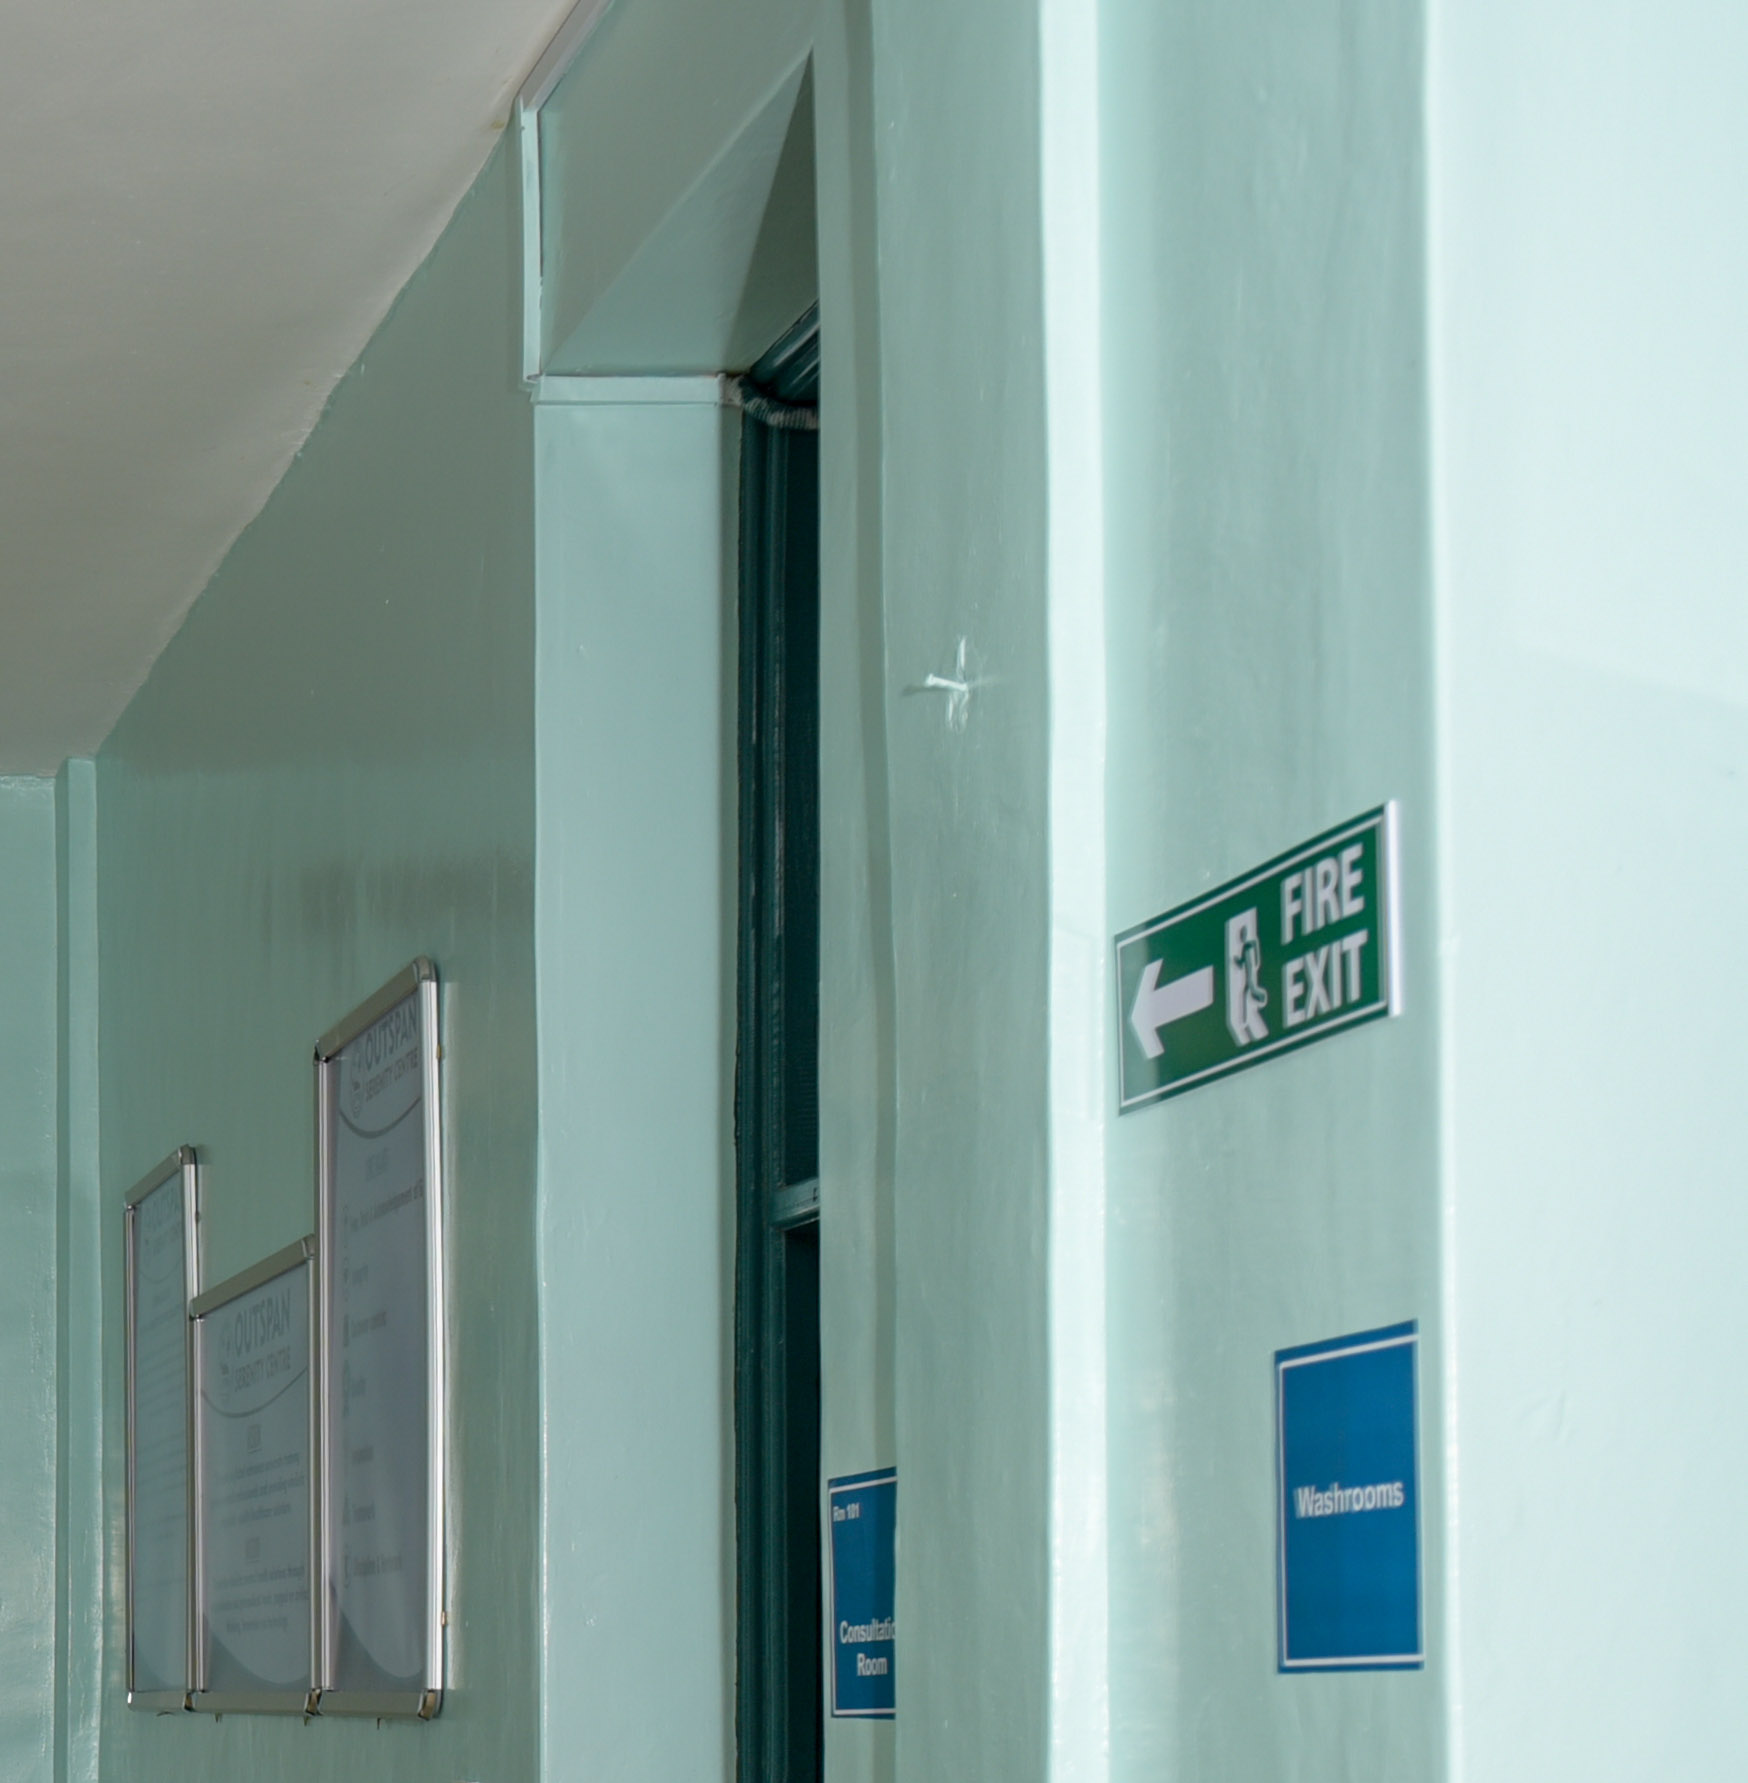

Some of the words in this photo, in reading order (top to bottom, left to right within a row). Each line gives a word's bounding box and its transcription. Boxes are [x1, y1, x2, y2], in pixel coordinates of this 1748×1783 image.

[1281, 842, 1364, 946] FIRE
[1282, 929, 1368, 1029] EXIT
[365, 997, 417, 1072] OUTSPAN
[234, 1287, 290, 1357] OUTSPAN
[1295, 1481, 1404, 1519] Washrooms
[857, 1653, 888, 1677] Room
